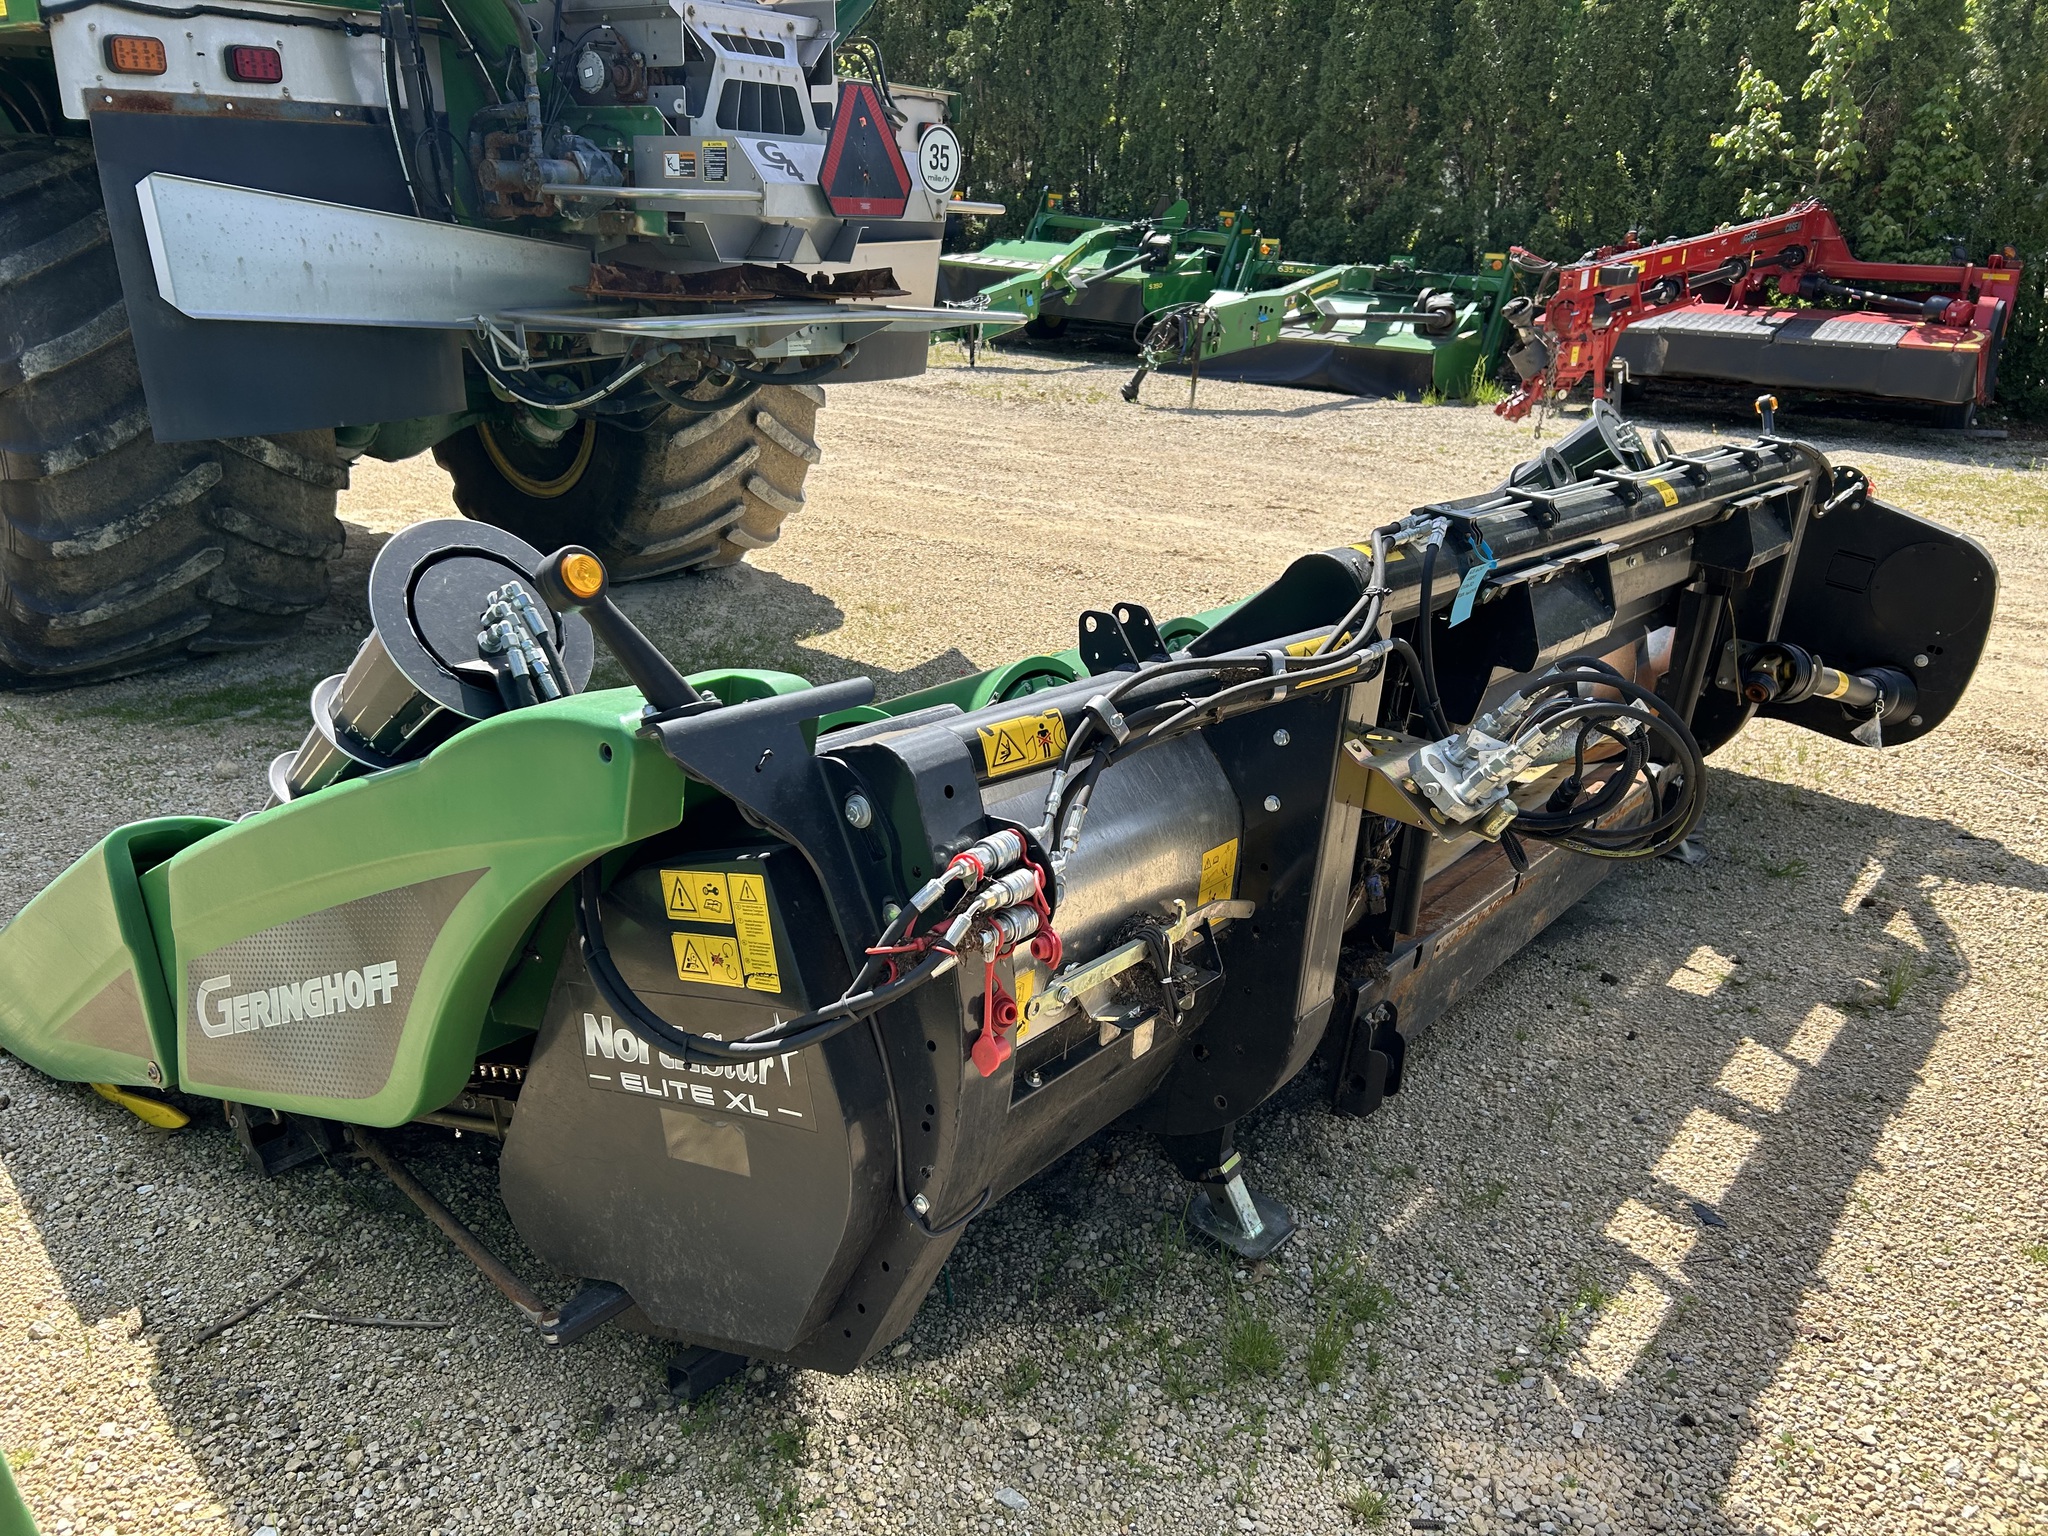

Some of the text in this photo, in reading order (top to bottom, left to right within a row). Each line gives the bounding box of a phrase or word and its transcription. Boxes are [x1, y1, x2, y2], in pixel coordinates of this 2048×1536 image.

[756, 141, 805, 182] G4
[929, 143, 950, 171] 35
[927, 174, 950, 183] mile/h
[1277, 265, 1294, 273] 635
[197, 960, 399, 1039] GERINGHOFF
[620, 1072, 769, 1117] ELITE XL
